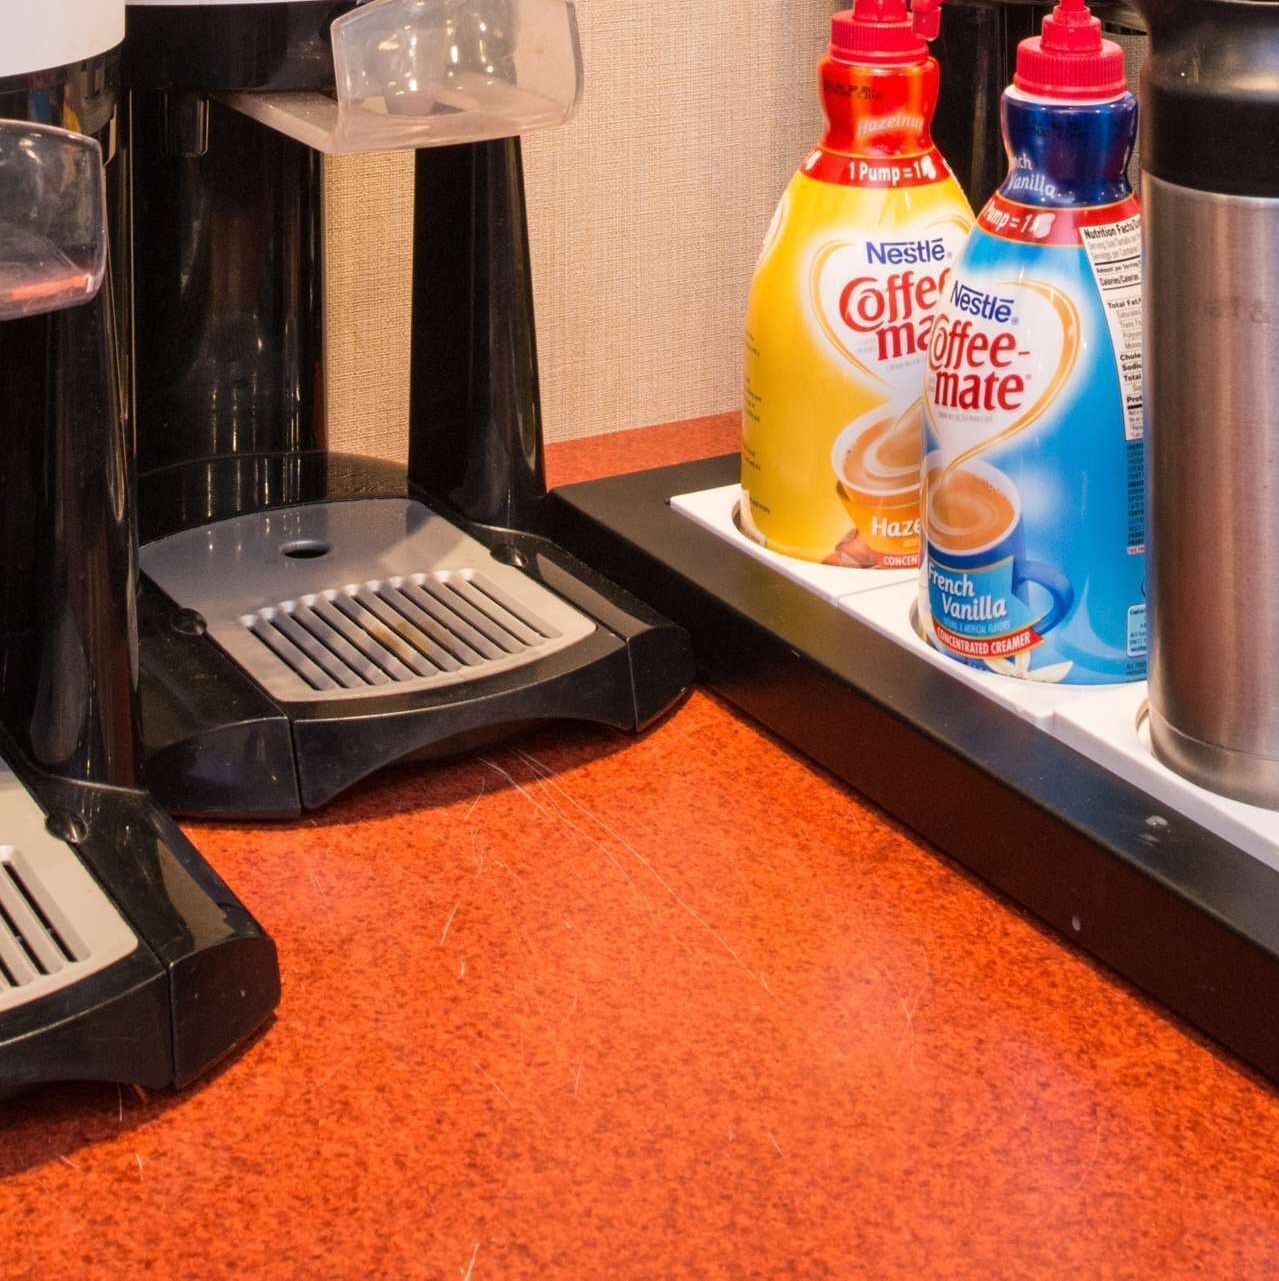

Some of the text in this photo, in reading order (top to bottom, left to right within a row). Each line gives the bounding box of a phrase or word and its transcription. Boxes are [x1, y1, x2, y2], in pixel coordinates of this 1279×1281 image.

[849, 162, 855, 180] 1
[859, 162, 901, 186] Pump
[1084, 223, 1117, 239] Nutrition
[866, 238, 945, 265] Nestlé
[950, 280, 1015, 323] Nestlé
[934, 371, 1025, 412] mate
[928, 561, 975, 597] French
[942, 591, 1008, 621] Vanilla
[937, 626, 1031, 656] CONCENTRATED CREAMER
